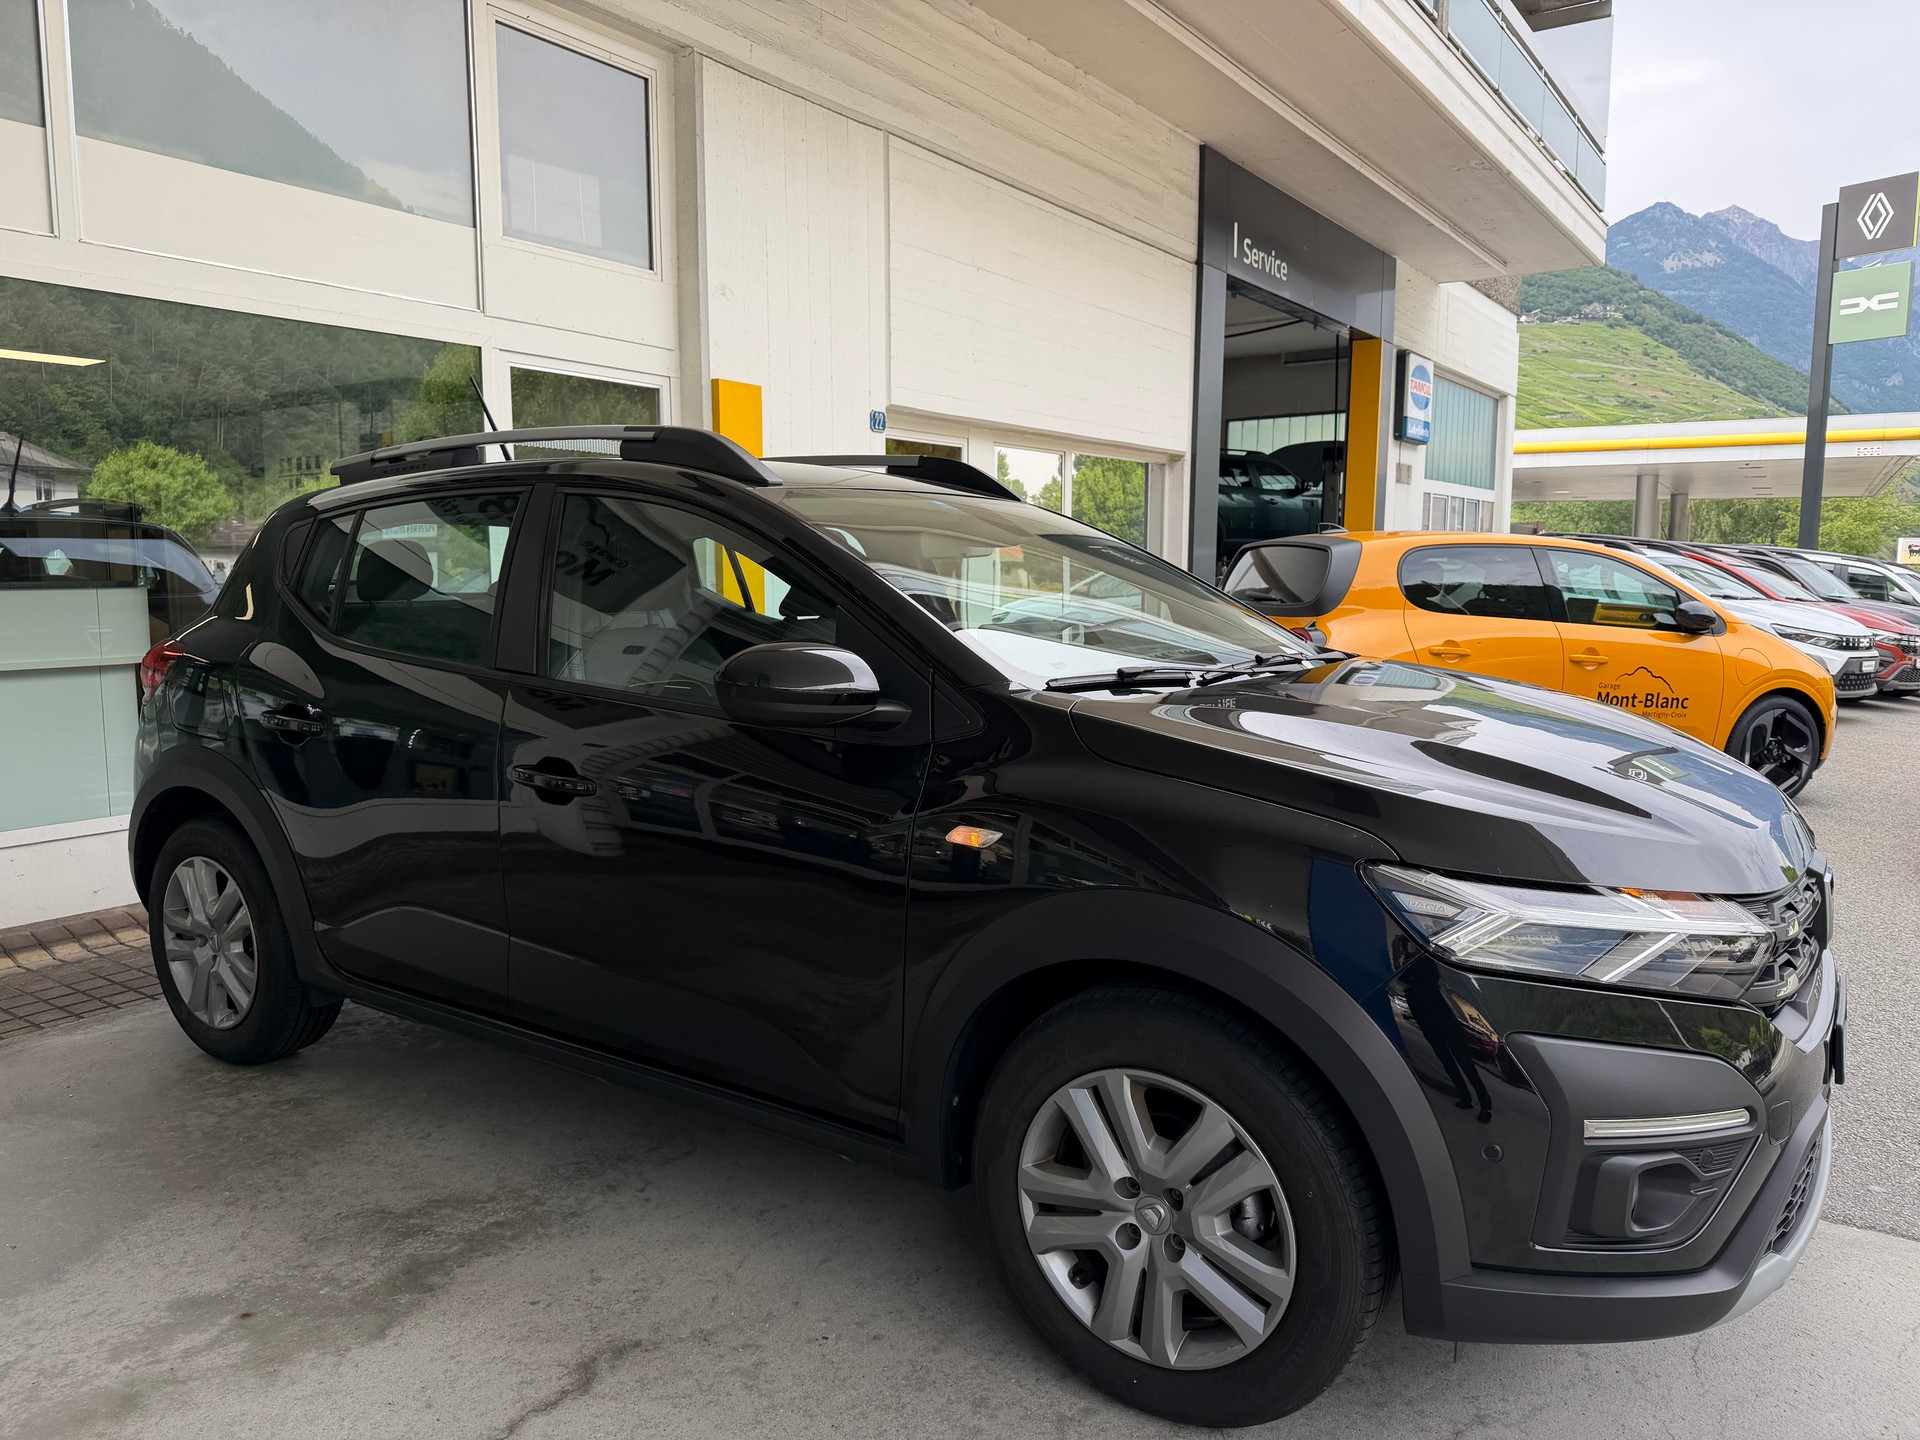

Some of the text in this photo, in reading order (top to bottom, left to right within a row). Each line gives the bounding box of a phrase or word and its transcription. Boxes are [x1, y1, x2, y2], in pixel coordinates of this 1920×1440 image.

[1243, 238, 1288, 281] Service
[1409, 379, 1431, 396] TAMOIL
[1598, 682, 1621, 690] Garage
[1596, 691, 1689, 709] Mont-Blanc
[1642, 710, 1687, 719] Martigny-Croix
[1408, 900, 1447, 913] DACIA
